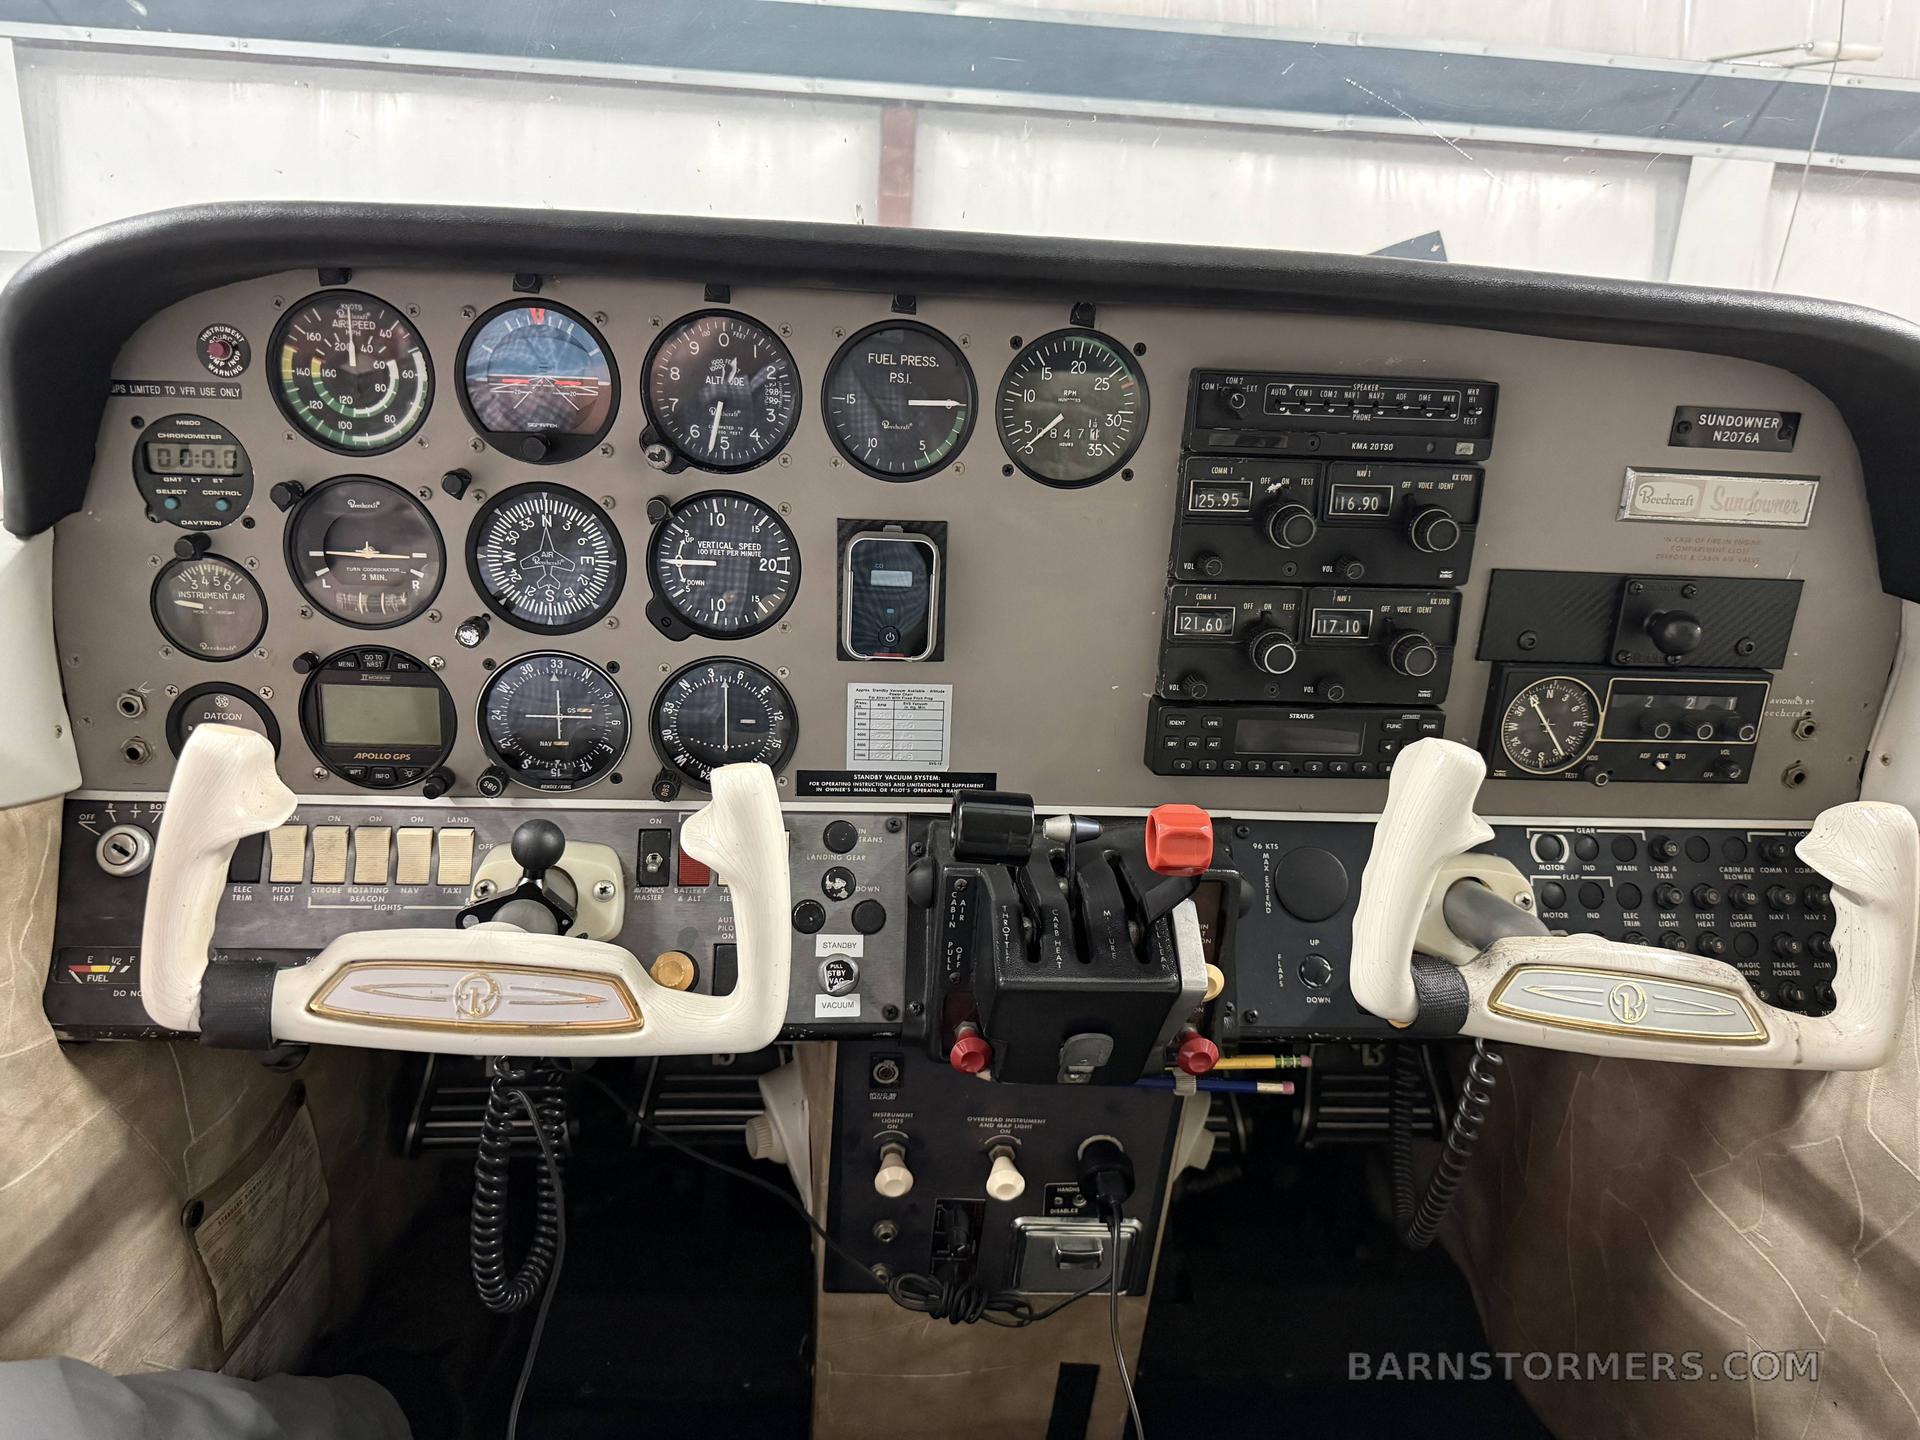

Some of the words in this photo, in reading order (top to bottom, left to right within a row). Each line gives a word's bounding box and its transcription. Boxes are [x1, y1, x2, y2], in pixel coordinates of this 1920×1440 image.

[332, 320, 376, 330] AIRSPEED
[201, 326, 245, 343] INSTRUMENT
[306, 332, 322, 341] 160
[868, 353, 897, 365] FUEL
[900, 355, 939, 368] PRESS.
[208, 363, 243, 377] WARNING
[1070, 360, 1087, 375] 20
[1094, 377, 1110, 391] 25
[1353, 384, 1379, 392] SPEAKER
[129, 385, 161, 394] LIMITED
[164, 386, 176, 395] TO
[179, 386, 196, 395] VFR
[200, 387, 216, 396] USE
[220, 387, 240, 398] ONLY
[338, 421, 353, 430] 100
[1698, 414, 1780, 429] SUNDOWNER
[1712, 431, 1760, 443] N2076A
[1301, 478, 1314, 486] TEST
[1438, 482, 1455, 490] IDENT
[1638, 484, 1694, 506] Beechcraft
[1710, 485, 1800, 514] Sundowner
[697, 541, 733, 550] VERTICAL
[738, 543, 762, 551] SPEED
[697, 548, 709, 556] 100
[741, 550, 762, 558] MINUTE
[1183, 562, 1195, 570] VOL
[1283, 603, 1296, 611] TEST
[1416, 606, 1432, 614] IDENT
[1180, 616, 1223, 632] 121.60
[1317, 620, 1360, 634] 117.10
[203, 712, 243, 721] DATCON
[354, 752, 392, 760] APOLLO
[392, 753, 411, 761] GPS
[822, 1001, 854, 1009] VACUUM
[1306, 996, 1331, 1004] DOWN
